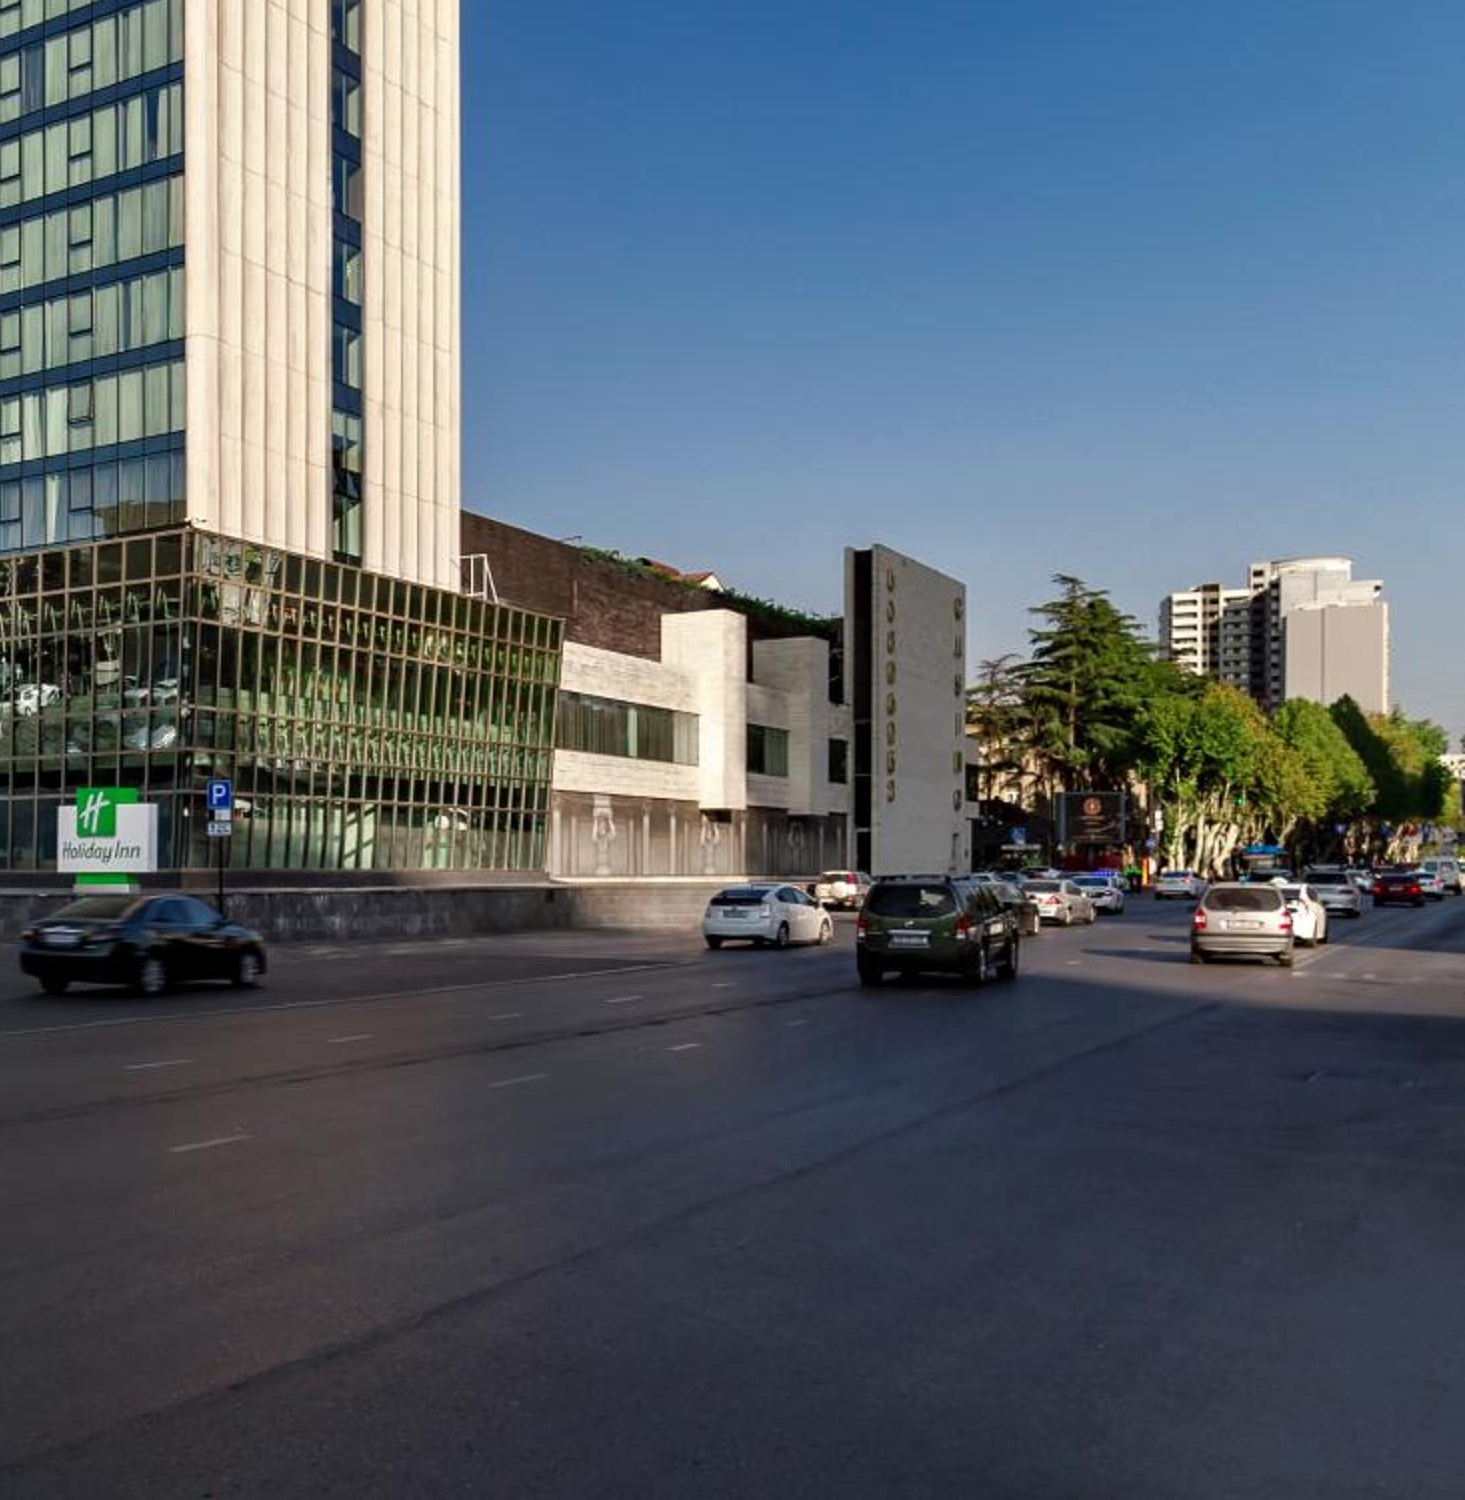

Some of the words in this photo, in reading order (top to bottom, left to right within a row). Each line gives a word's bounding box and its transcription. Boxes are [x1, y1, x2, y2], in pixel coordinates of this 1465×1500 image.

[212, 784, 227, 805] P
[62, 840, 113, 863] Holiday
[115, 840, 141, 859] Inn
